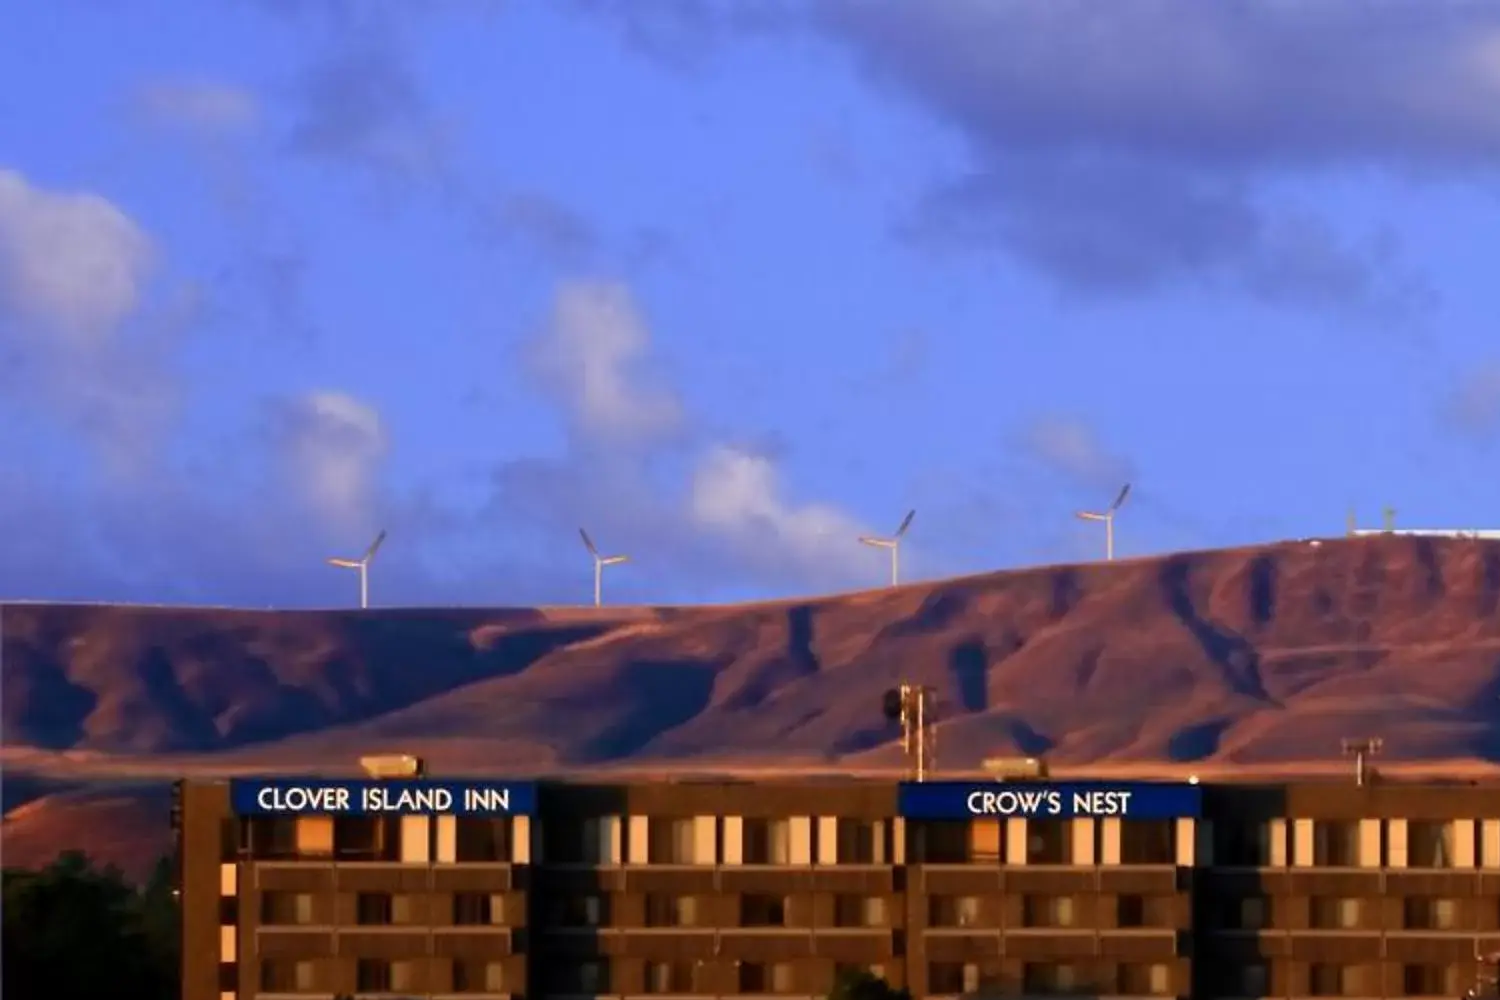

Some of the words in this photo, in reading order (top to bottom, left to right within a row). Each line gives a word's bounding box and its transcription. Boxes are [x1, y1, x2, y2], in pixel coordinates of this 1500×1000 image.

[258, 788, 349, 810] CLOVER
[363, 788, 452, 810] ISLAND
[465, 789, 508, 810] INN
[968, 791, 1060, 814] CROW'S
[1074, 792, 1131, 814] NEST
